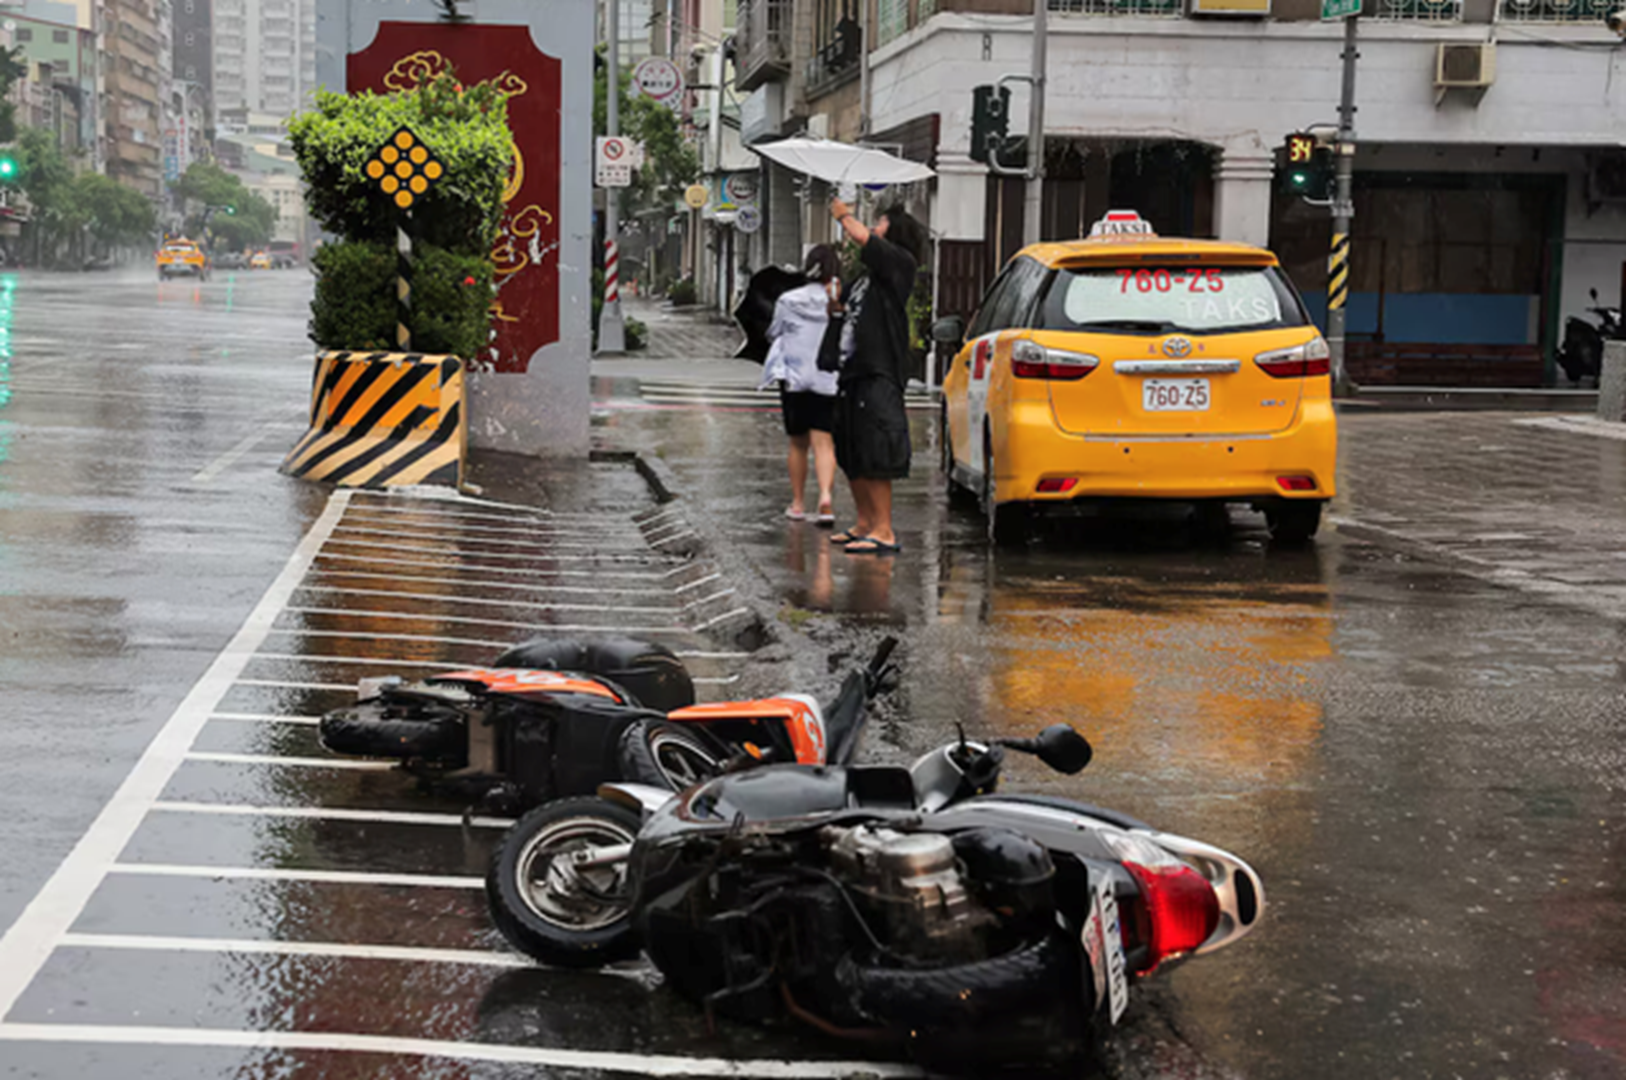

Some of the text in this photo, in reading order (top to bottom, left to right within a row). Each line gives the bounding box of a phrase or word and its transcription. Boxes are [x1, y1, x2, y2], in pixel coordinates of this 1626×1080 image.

[1290, 138, 1311, 162] 34
[1116, 268, 1224, 293] 760-Z5
[1180, 298, 1282, 321] TAKSI
